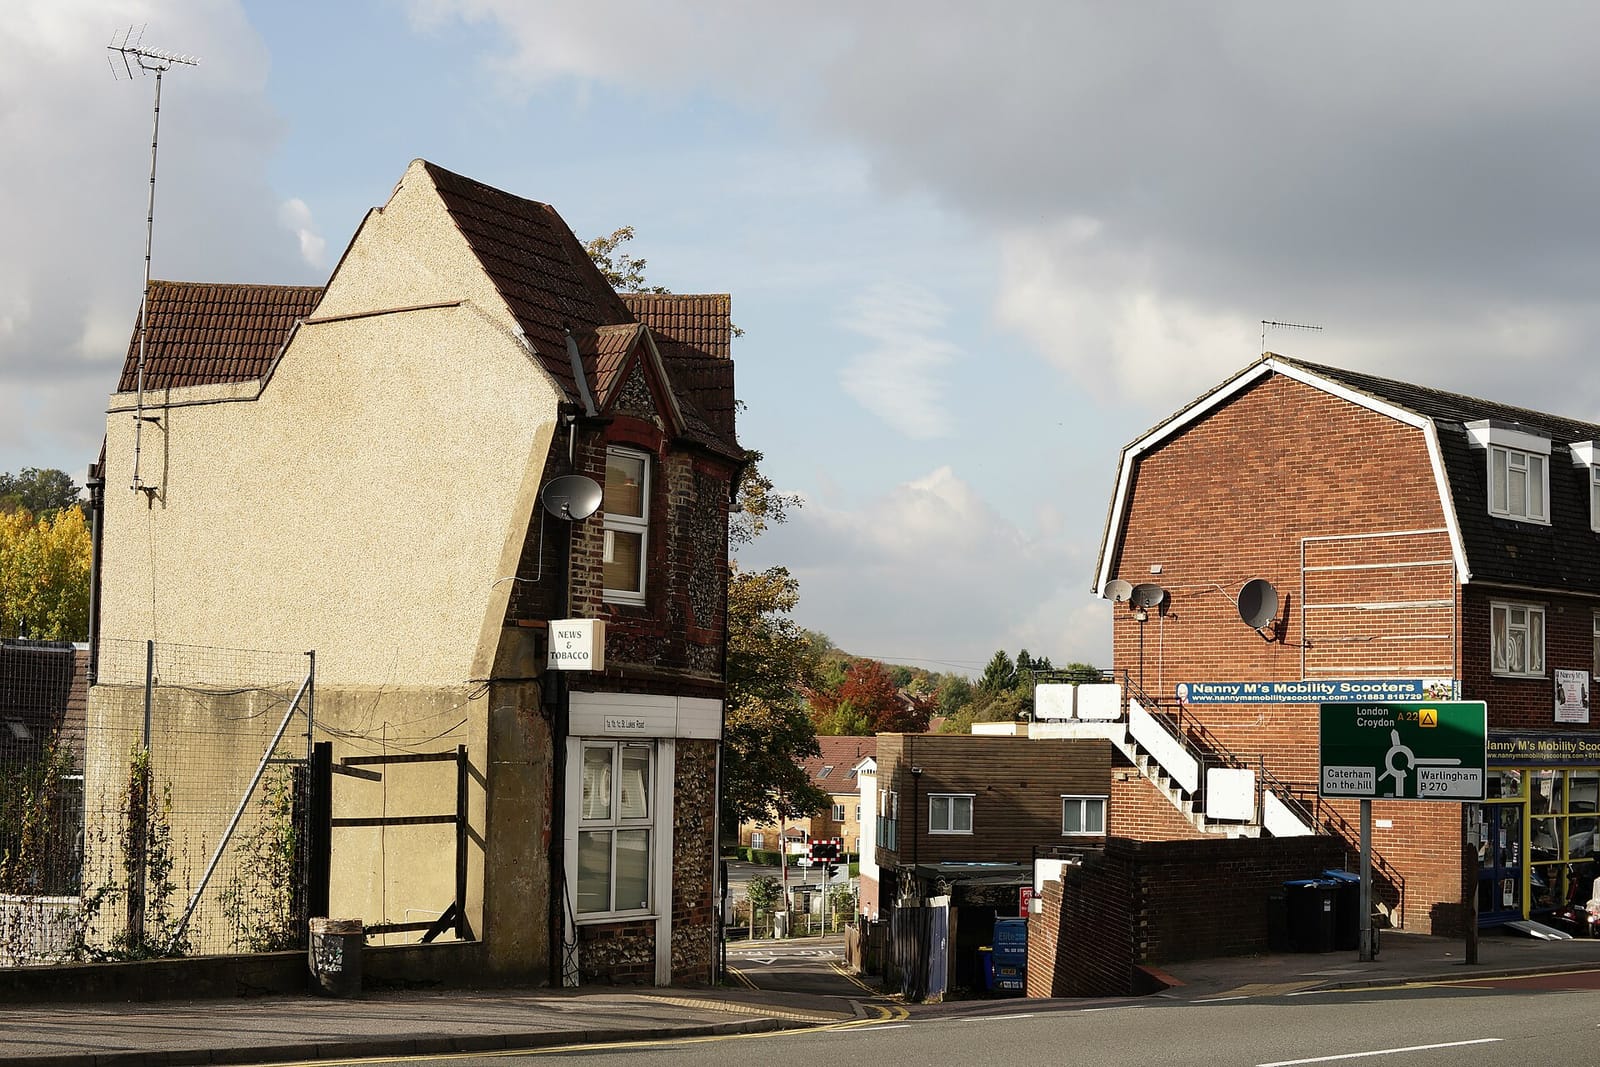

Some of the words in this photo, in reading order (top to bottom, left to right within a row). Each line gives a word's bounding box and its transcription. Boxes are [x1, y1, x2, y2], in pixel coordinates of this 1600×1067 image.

[558, 630, 582, 639] NEWS
[566, 641, 572, 650] &
[550, 651, 589, 660] TOBACCO
[1192, 683, 1240, 694] Nanny
[1244, 683, 1270, 693] M's
[1274, 683, 1335, 694] Mobility
[1340, 682, 1415, 693] Scooters
[1356, 706, 1389, 716] London
[1356, 717, 1395, 729] Croydon
[1397, 712, 1404, 721] A
[1406, 712, 1418, 721] 22
[1518, 740, 1536, 751] M's
[1538, 740, 1577, 753] Mobility
[1327, 769, 1372, 779] Caterham
[1421, 770, 1478, 782] Warlingham
[1326, 781, 1337, 789] on
[1340, 779, 1355, 790] the
[1357, 779, 1373, 790] hill
[1420, 782, 1427, 792] B
[1428, 782, 1448, 792] 270
